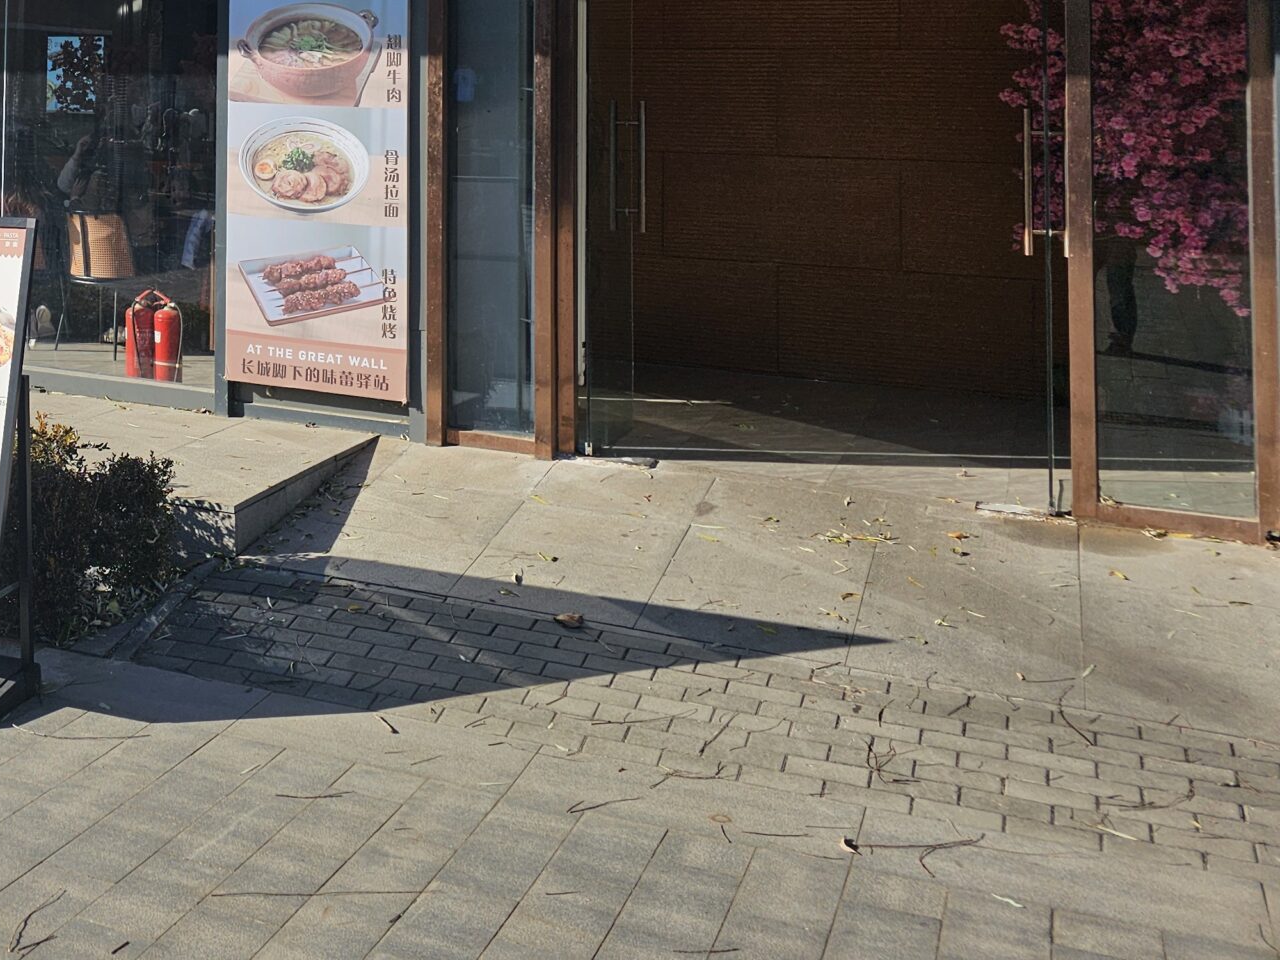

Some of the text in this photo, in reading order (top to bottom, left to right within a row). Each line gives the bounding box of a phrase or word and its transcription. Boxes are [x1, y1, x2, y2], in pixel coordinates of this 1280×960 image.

[386, 33, 402, 103] 翘脚牛肉
[384, 149, 400, 218] 骨汤拉面
[381, 268, 398, 340] 特色烧烤
[241, 358, 390, 391] 长城脚下的味蕾驿站
[246, 343, 389, 370] AT THE GREAT WALL
